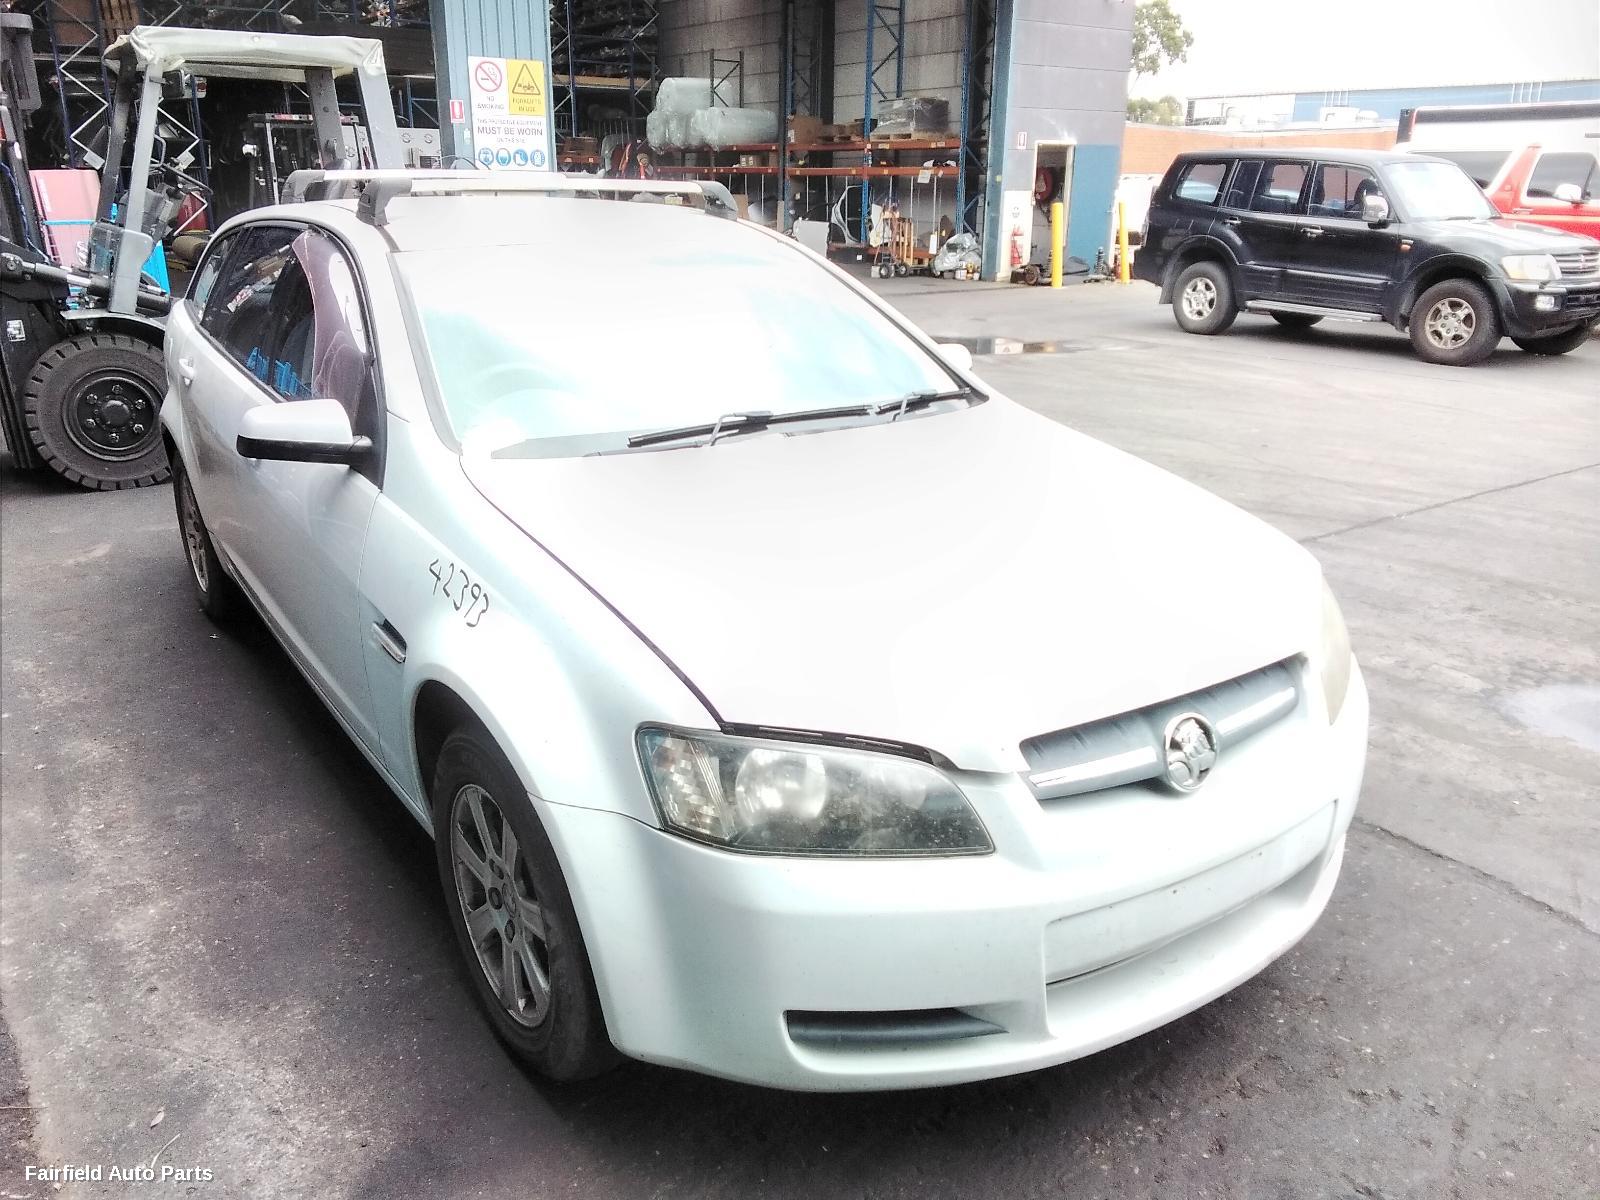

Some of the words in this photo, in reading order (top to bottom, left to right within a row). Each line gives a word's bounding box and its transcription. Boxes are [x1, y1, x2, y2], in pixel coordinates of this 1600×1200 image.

[477, 126, 502, 135] MUST
[517, 128, 543, 136] WORN
[429, 558, 489, 628] 42393
